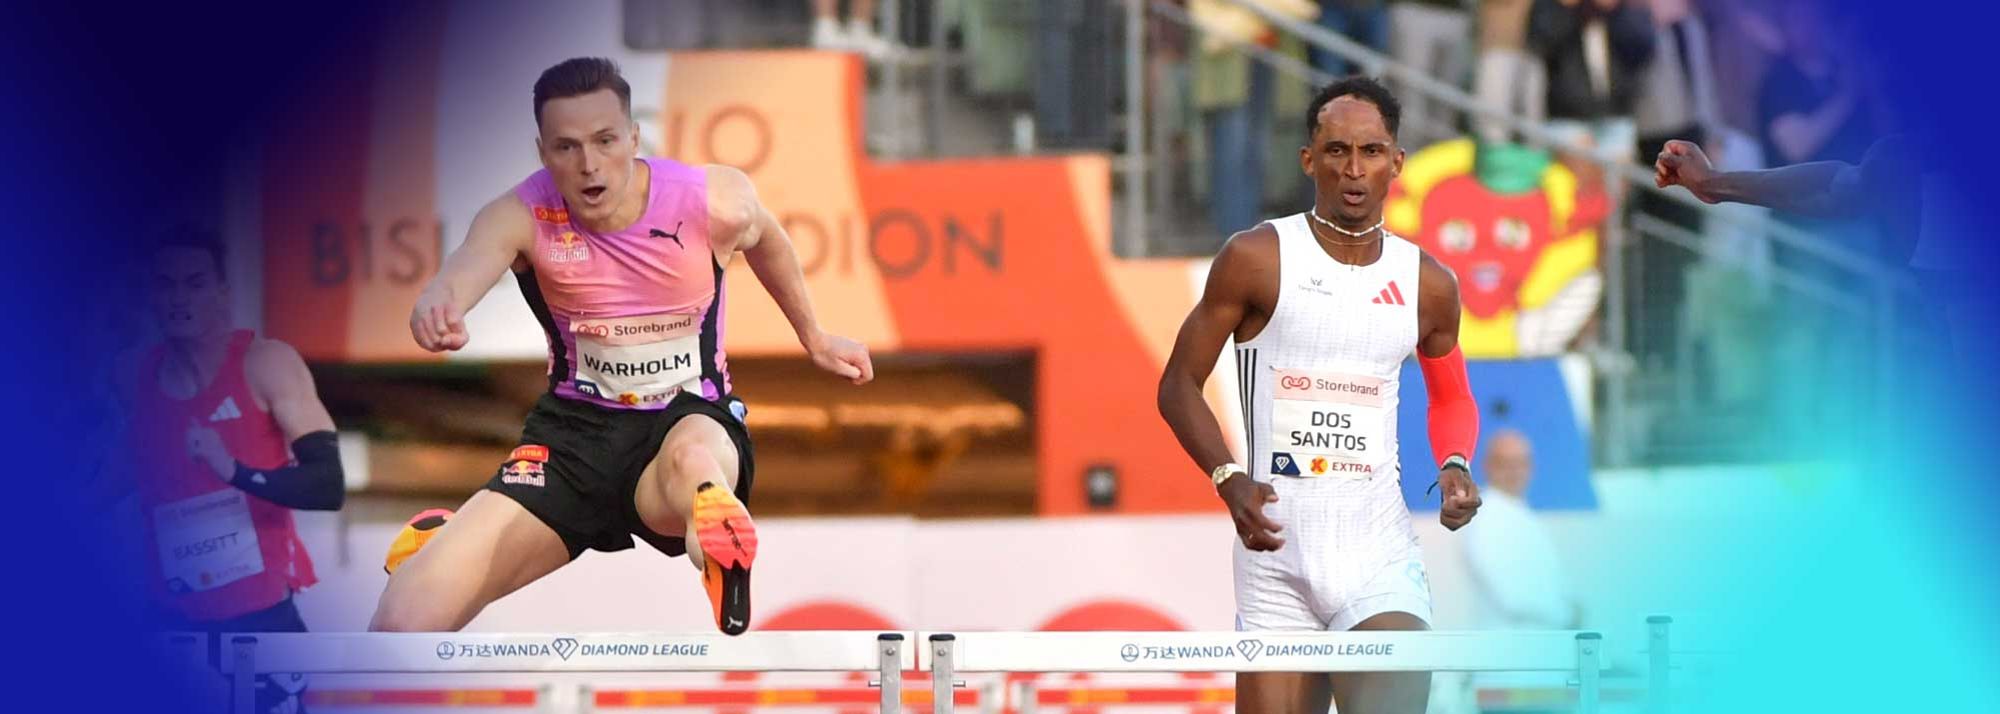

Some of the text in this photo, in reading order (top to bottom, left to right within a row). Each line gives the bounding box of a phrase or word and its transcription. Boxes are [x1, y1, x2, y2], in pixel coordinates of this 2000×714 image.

[614, 317, 692, 336] Storebrand
[584, 353, 691, 376] WARHOLM
[1316, 379, 1379, 396] Storebrand
[1311, 411, 1352, 429] DOS
[1290, 430, 1367, 451] SANTOS
[1332, 462, 1372, 473] EXTRA
[581, 644, 649, 656] DIAMOND
[652, 644, 709, 656] LEAGUE
[1266, 644, 1334, 657] DIAMOND
[1337, 643, 1395, 656] LEAGUE
